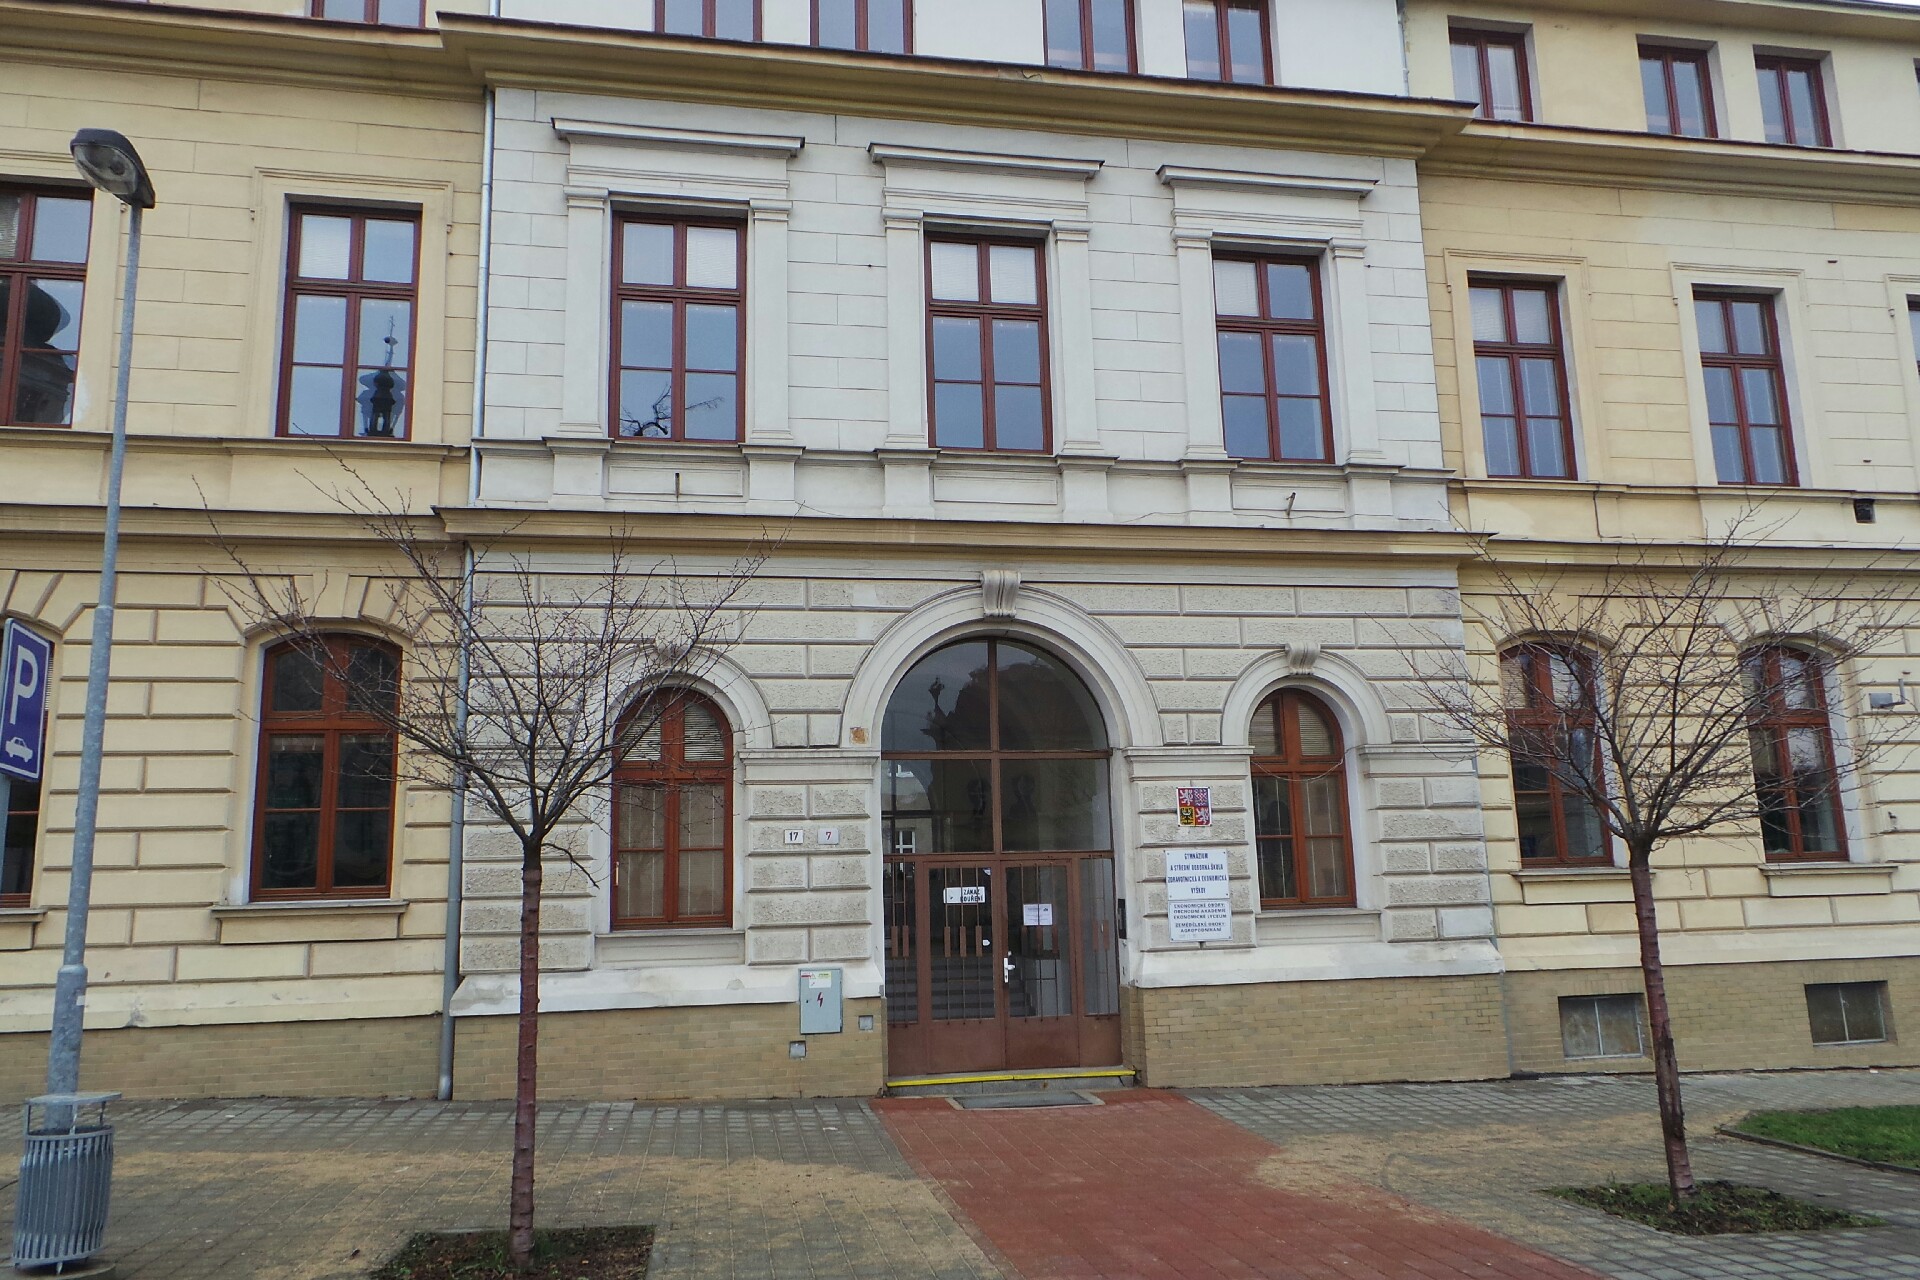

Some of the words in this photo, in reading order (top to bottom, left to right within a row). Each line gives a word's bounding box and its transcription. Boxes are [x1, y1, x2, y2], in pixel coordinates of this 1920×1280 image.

[10, 644, 38, 725] P
[789, 831, 799, 841] 17
[825, 831, 832, 840] 7
